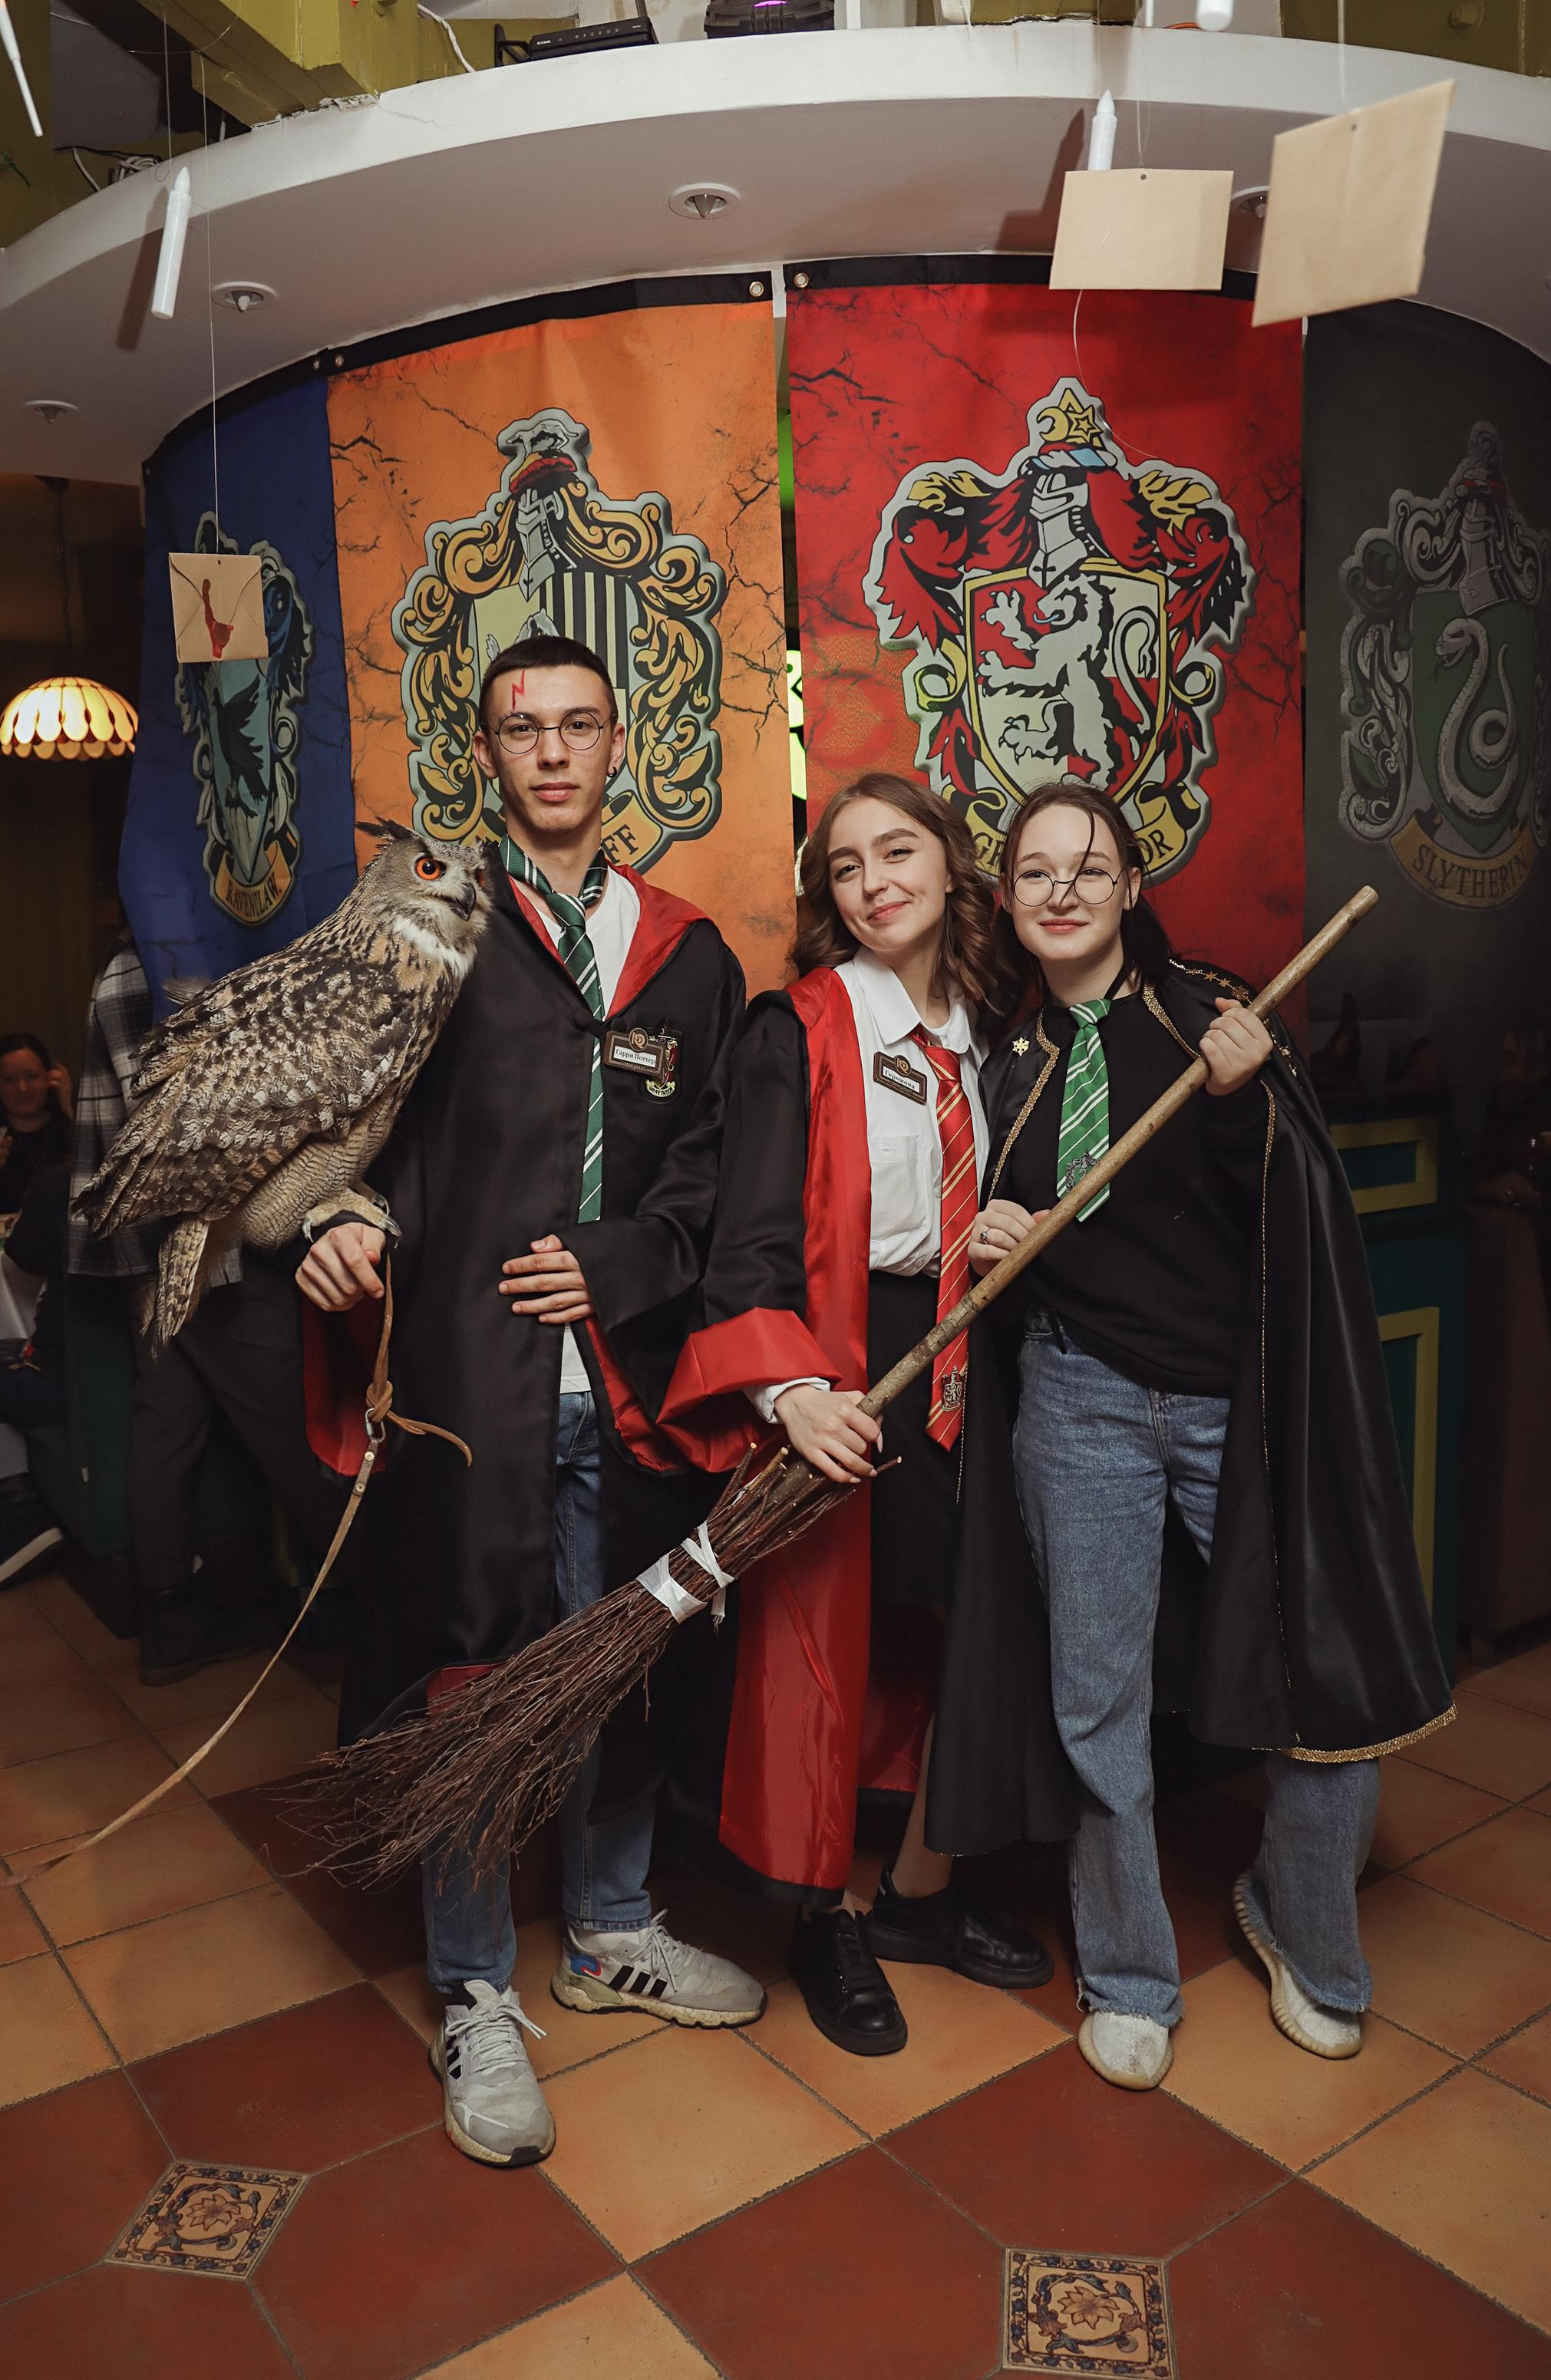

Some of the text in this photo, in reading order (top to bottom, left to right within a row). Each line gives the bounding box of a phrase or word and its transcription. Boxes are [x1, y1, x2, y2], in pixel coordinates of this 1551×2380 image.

[1413, 844, 1528, 898] SLYTHERIN
[615, 1048, 655, 1065] Гарри Поттер
[885, 1070, 915, 1089] Гермиона
